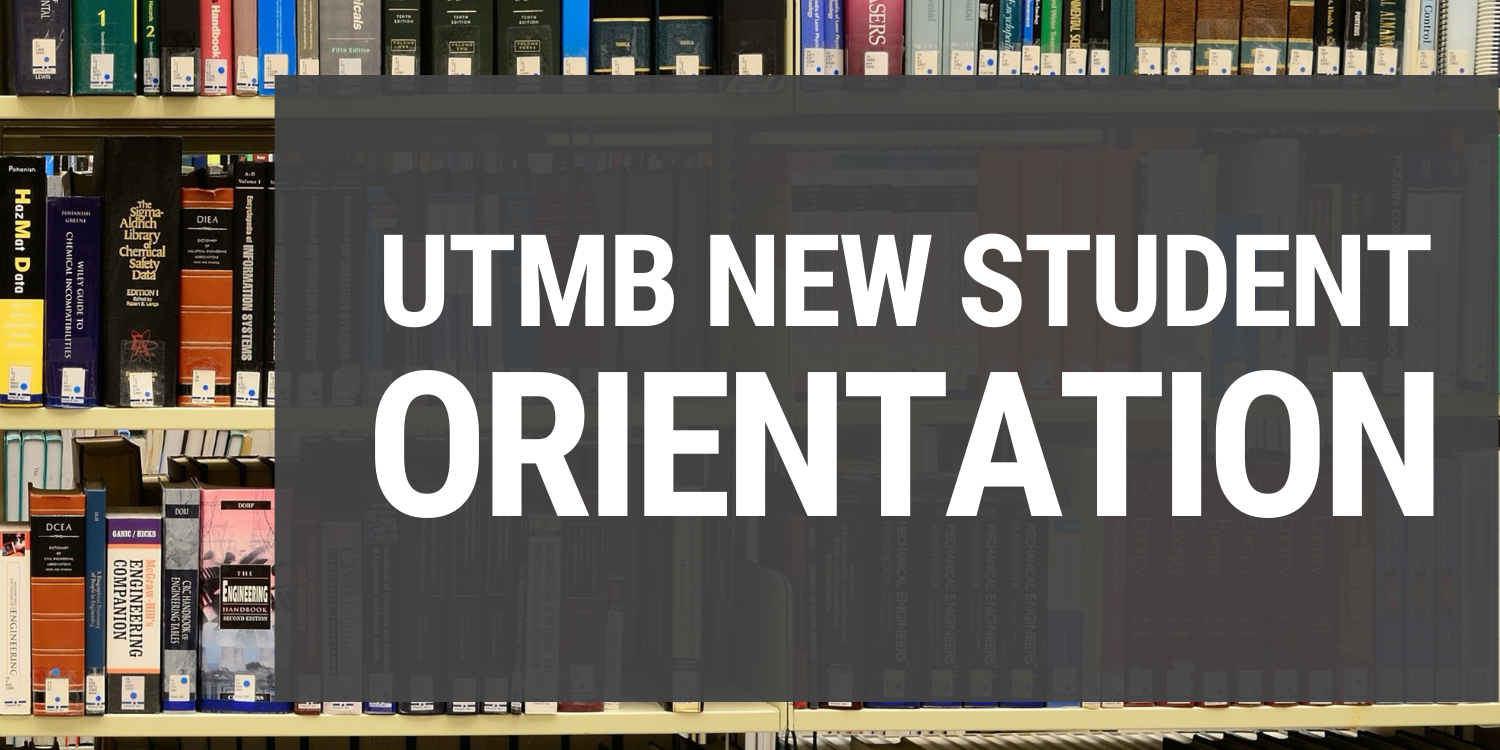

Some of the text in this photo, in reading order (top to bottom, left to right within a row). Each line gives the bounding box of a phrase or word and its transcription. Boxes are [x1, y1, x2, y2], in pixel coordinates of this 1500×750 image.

[97, 10, 106, 27] 1
[1422, 5, 1434, 44] Control
[145, 26, 156, 37] 2
[211, 5, 221, 59] Handbook
[349, 46, 371, 54] Edition
[137, 199, 152, 209] The
[129, 206, 164, 220] Sigma-
[196, 215, 219, 224] DIEA
[245, 195, 254, 235] Encyclopedia
[119, 216, 157, 229] Aldrich
[14, 188, 31, 294] HazMat Data
[124, 228, 161, 245] Library
[119, 244, 166, 258] Chemical
[129, 257, 160, 273] Safety
[131, 269, 157, 281] Data
[242, 244, 254, 311] INFORMATION
[64, 231, 74, 359] CHEMICAL INCOMPATIBILITIES
[76, 261, 85, 330] WILEY GUIDE TO
[126, 288, 155, 296] EDITION
[241, 313, 253, 361] SYSTEMS
[174, 508, 190, 516] DORF
[45, 523, 72, 532] DCEA
[112, 530, 131, 538] GANIC
[136, 530, 157, 538] HICKS
[145, 559, 156, 628] McGraw-Hill's
[182, 580, 192, 595] CRC
[222, 579, 269, 603] ENGINEERING
[113, 559, 127, 641] COMPANION
[129, 559, 143, 658] ENGINEERING
[170, 576, 181, 644] ENGINEERING TABLES
[181, 595, 192, 633] HANDBOOK
